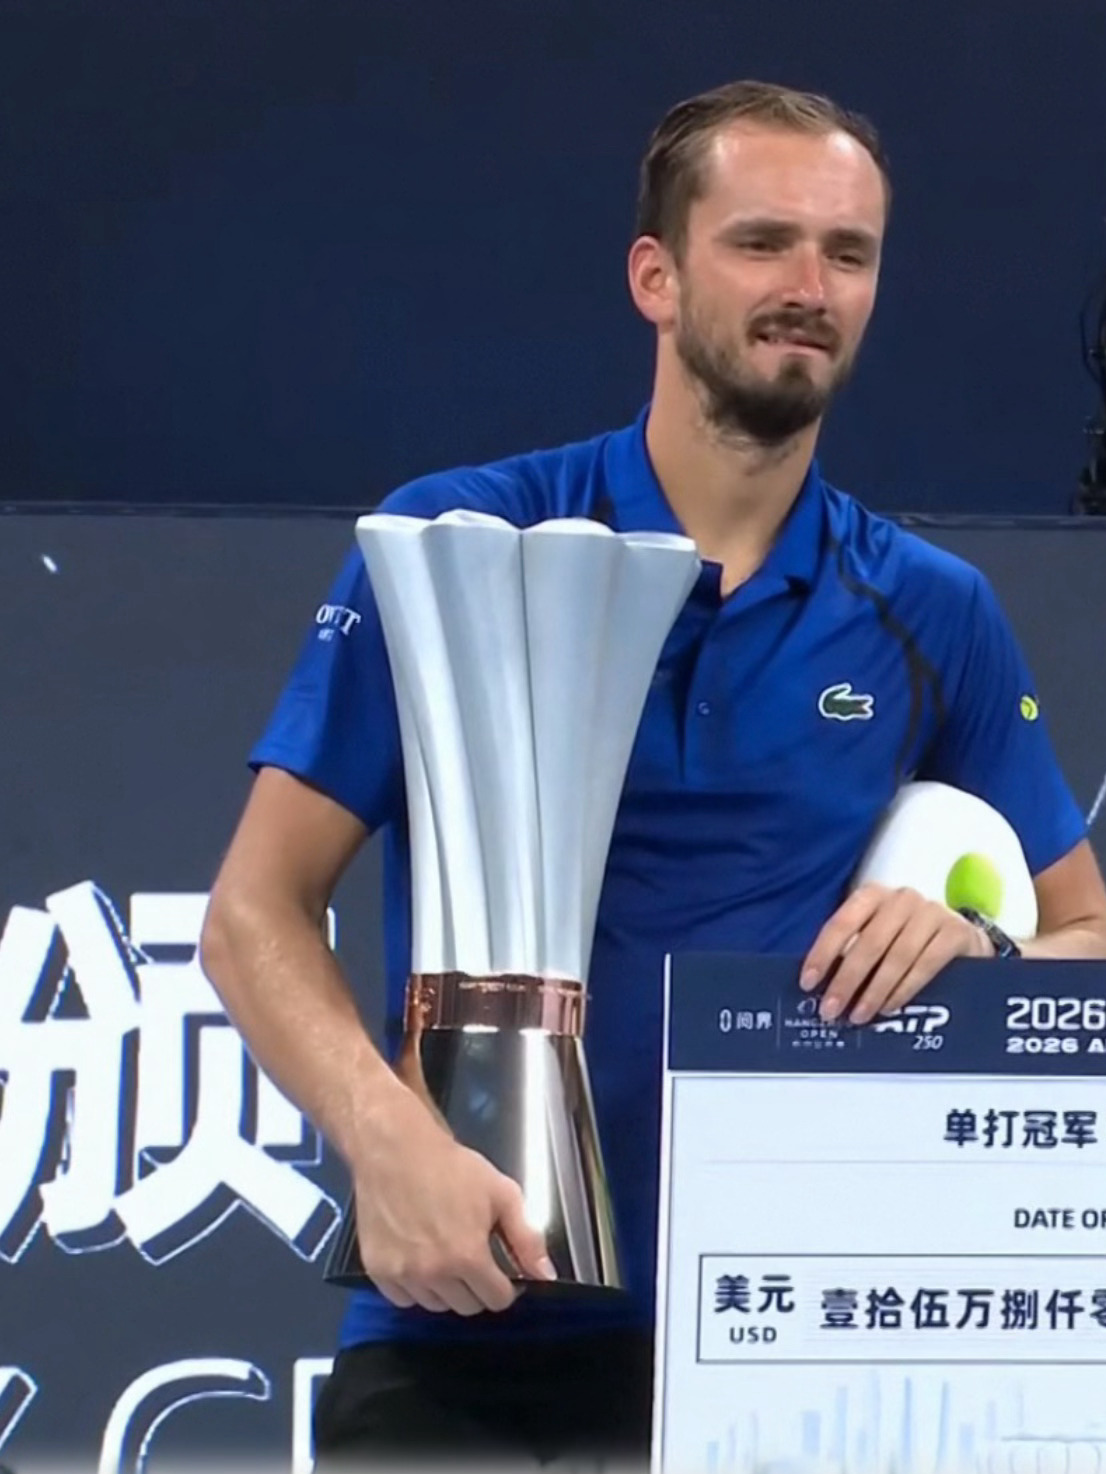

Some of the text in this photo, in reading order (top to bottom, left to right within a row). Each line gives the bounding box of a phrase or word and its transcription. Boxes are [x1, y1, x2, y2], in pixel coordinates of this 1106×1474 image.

[801, 1030, 838, 1039] OPEN
[912, 1035, 943, 1050] 250
[1006, 1038, 1079, 1054] 2026
[944, 1109, 1098, 1148] 单打冠军
[1014, 1208, 1075, 1230] DATE
[713, 1274, 796, 1314] 美元
[728, 1326, 778, 1344] USD
